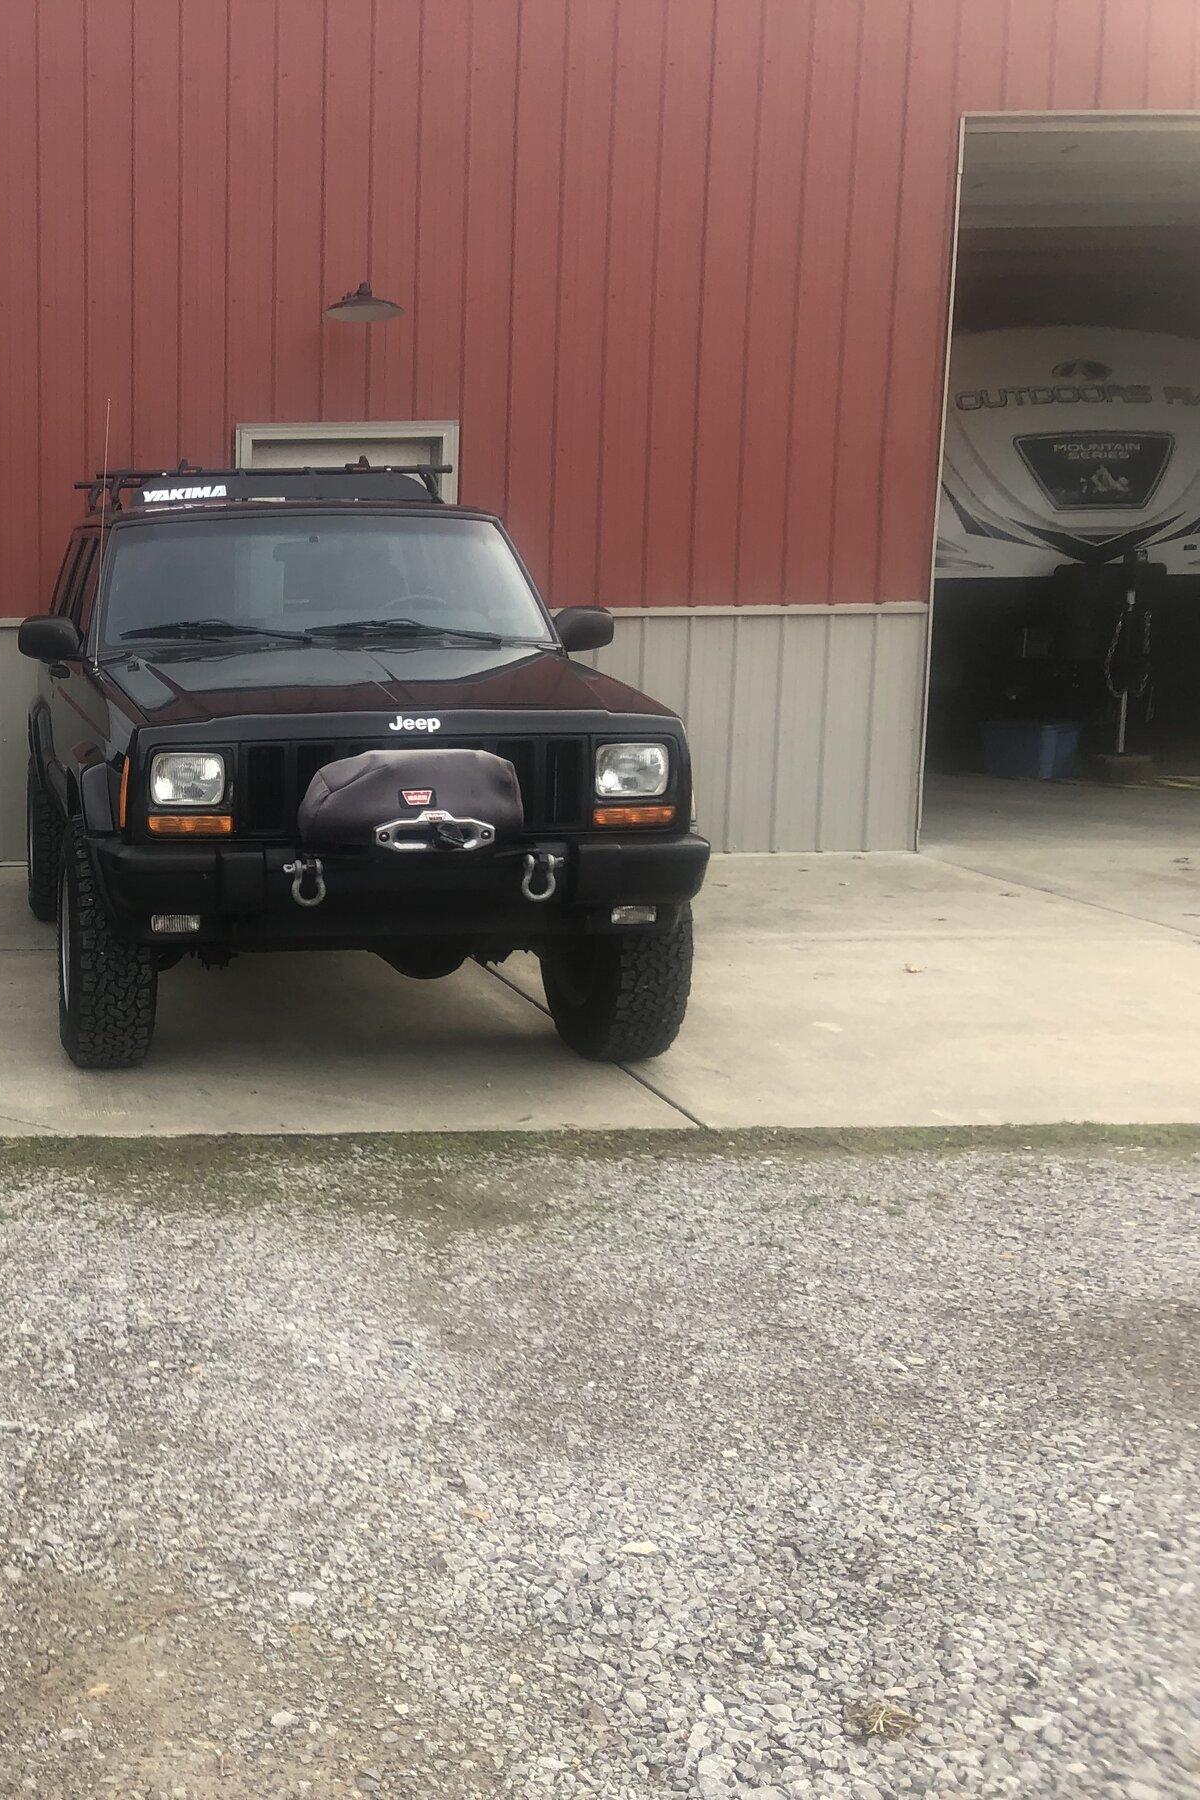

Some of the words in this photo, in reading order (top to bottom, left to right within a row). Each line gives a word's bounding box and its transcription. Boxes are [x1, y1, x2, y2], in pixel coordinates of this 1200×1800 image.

[955, 384, 1152, 410] OUTDOORS
[1053, 442, 1141, 452] MOUNTAIN
[1067, 451, 1130, 459] SERIES
[143, 485, 227, 502] YAKIMA
[388, 716, 441, 732] Jeep
